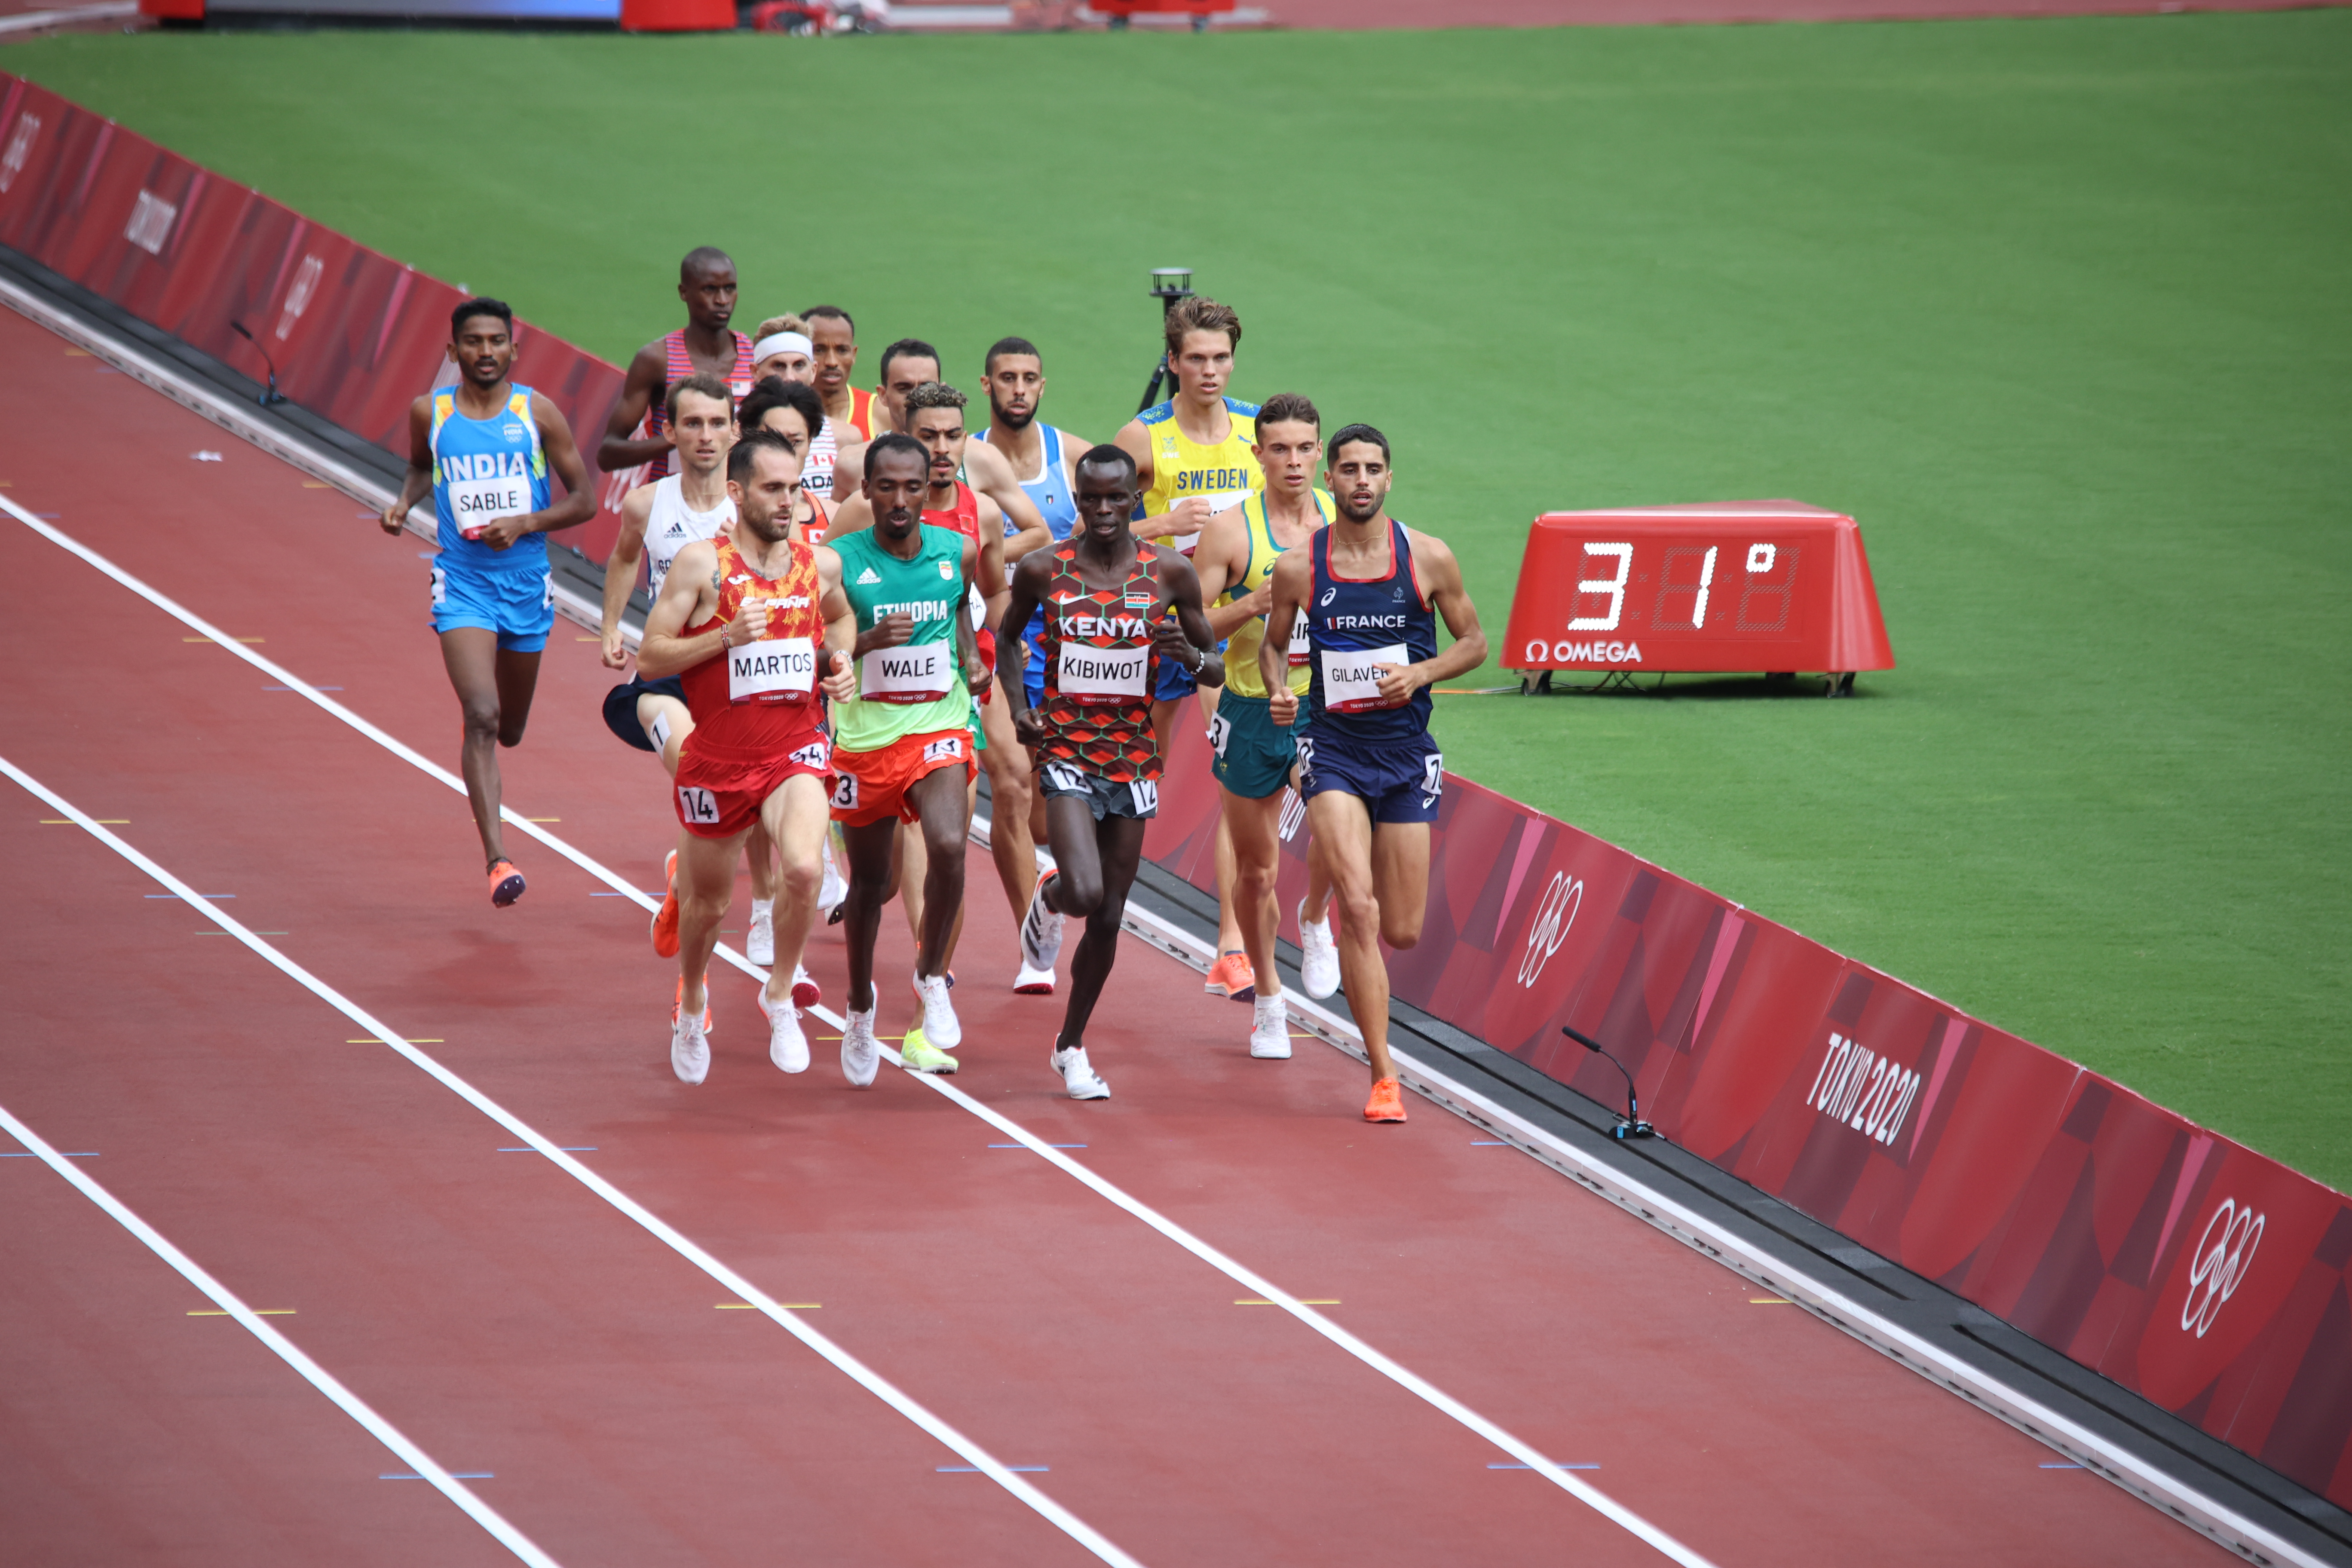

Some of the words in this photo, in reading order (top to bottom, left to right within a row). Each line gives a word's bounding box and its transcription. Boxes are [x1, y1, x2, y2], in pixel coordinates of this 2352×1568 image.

[441, 452, 528, 482] INDIA
[1177, 469, 1247, 490] SWEDEN
[460, 490, 518, 512] SABLE
[856, 577, 881, 585] adidas
[740, 596, 810, 609] EPAÑA
[1059, 616, 1147, 638] KENYA
[1336, 615, 1406, 629] FRANCE
[1554, 641, 1643, 662] OMEGA
[735, 653, 812, 677] MARTOS
[882, 657, 935, 678] WALE
[1063, 656, 1143, 680] KIBIWOT
[1332, 666, 1389, 682] GILAVER
[683, 790, 713, 820] 14
